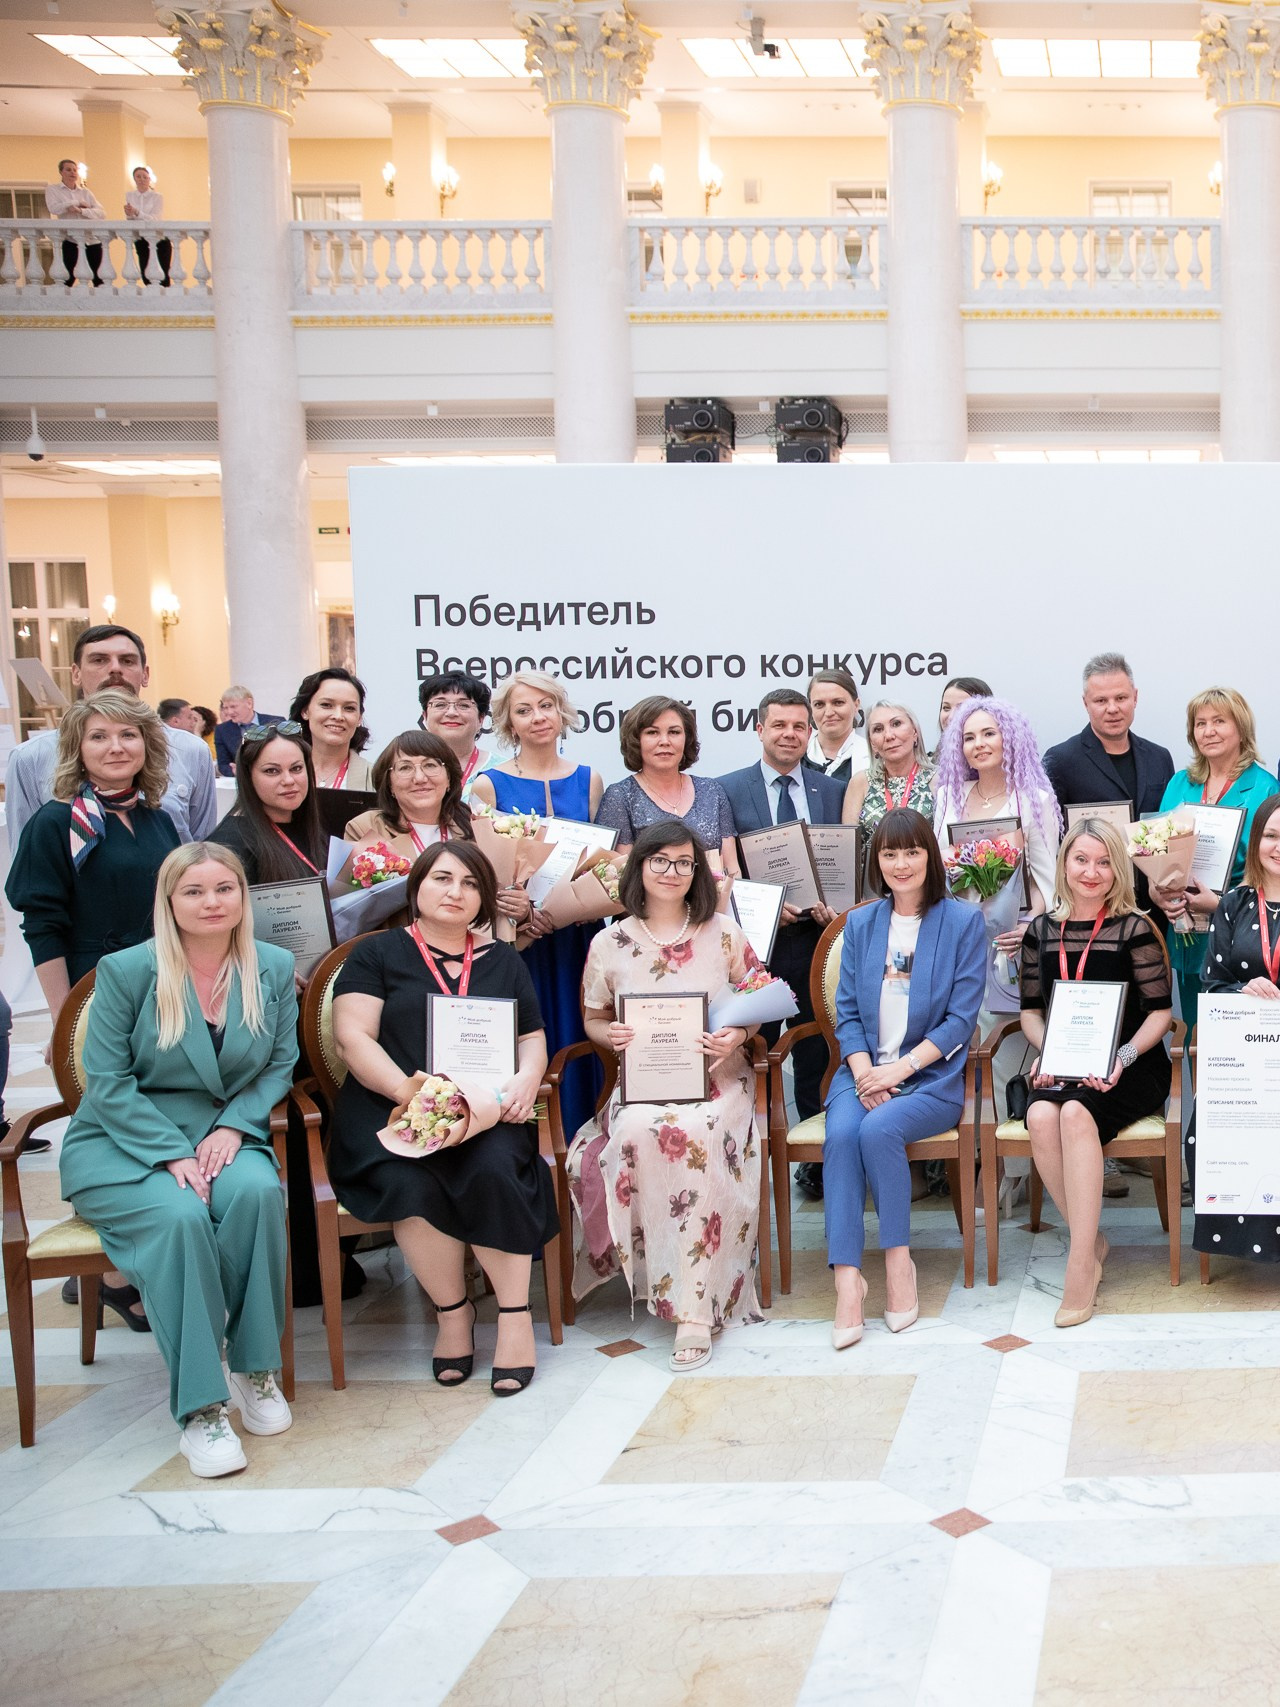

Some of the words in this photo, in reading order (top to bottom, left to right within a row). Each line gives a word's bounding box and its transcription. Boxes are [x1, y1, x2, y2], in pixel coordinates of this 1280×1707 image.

[414, 594, 656, 632] Победитель
[416, 647, 746, 688] Всероссийского
[760, 651, 948, 686] конкурса
[272, 920, 299, 929] ДИПЛОМ
[272, 926, 302, 934] ЛАУРЕАТА
